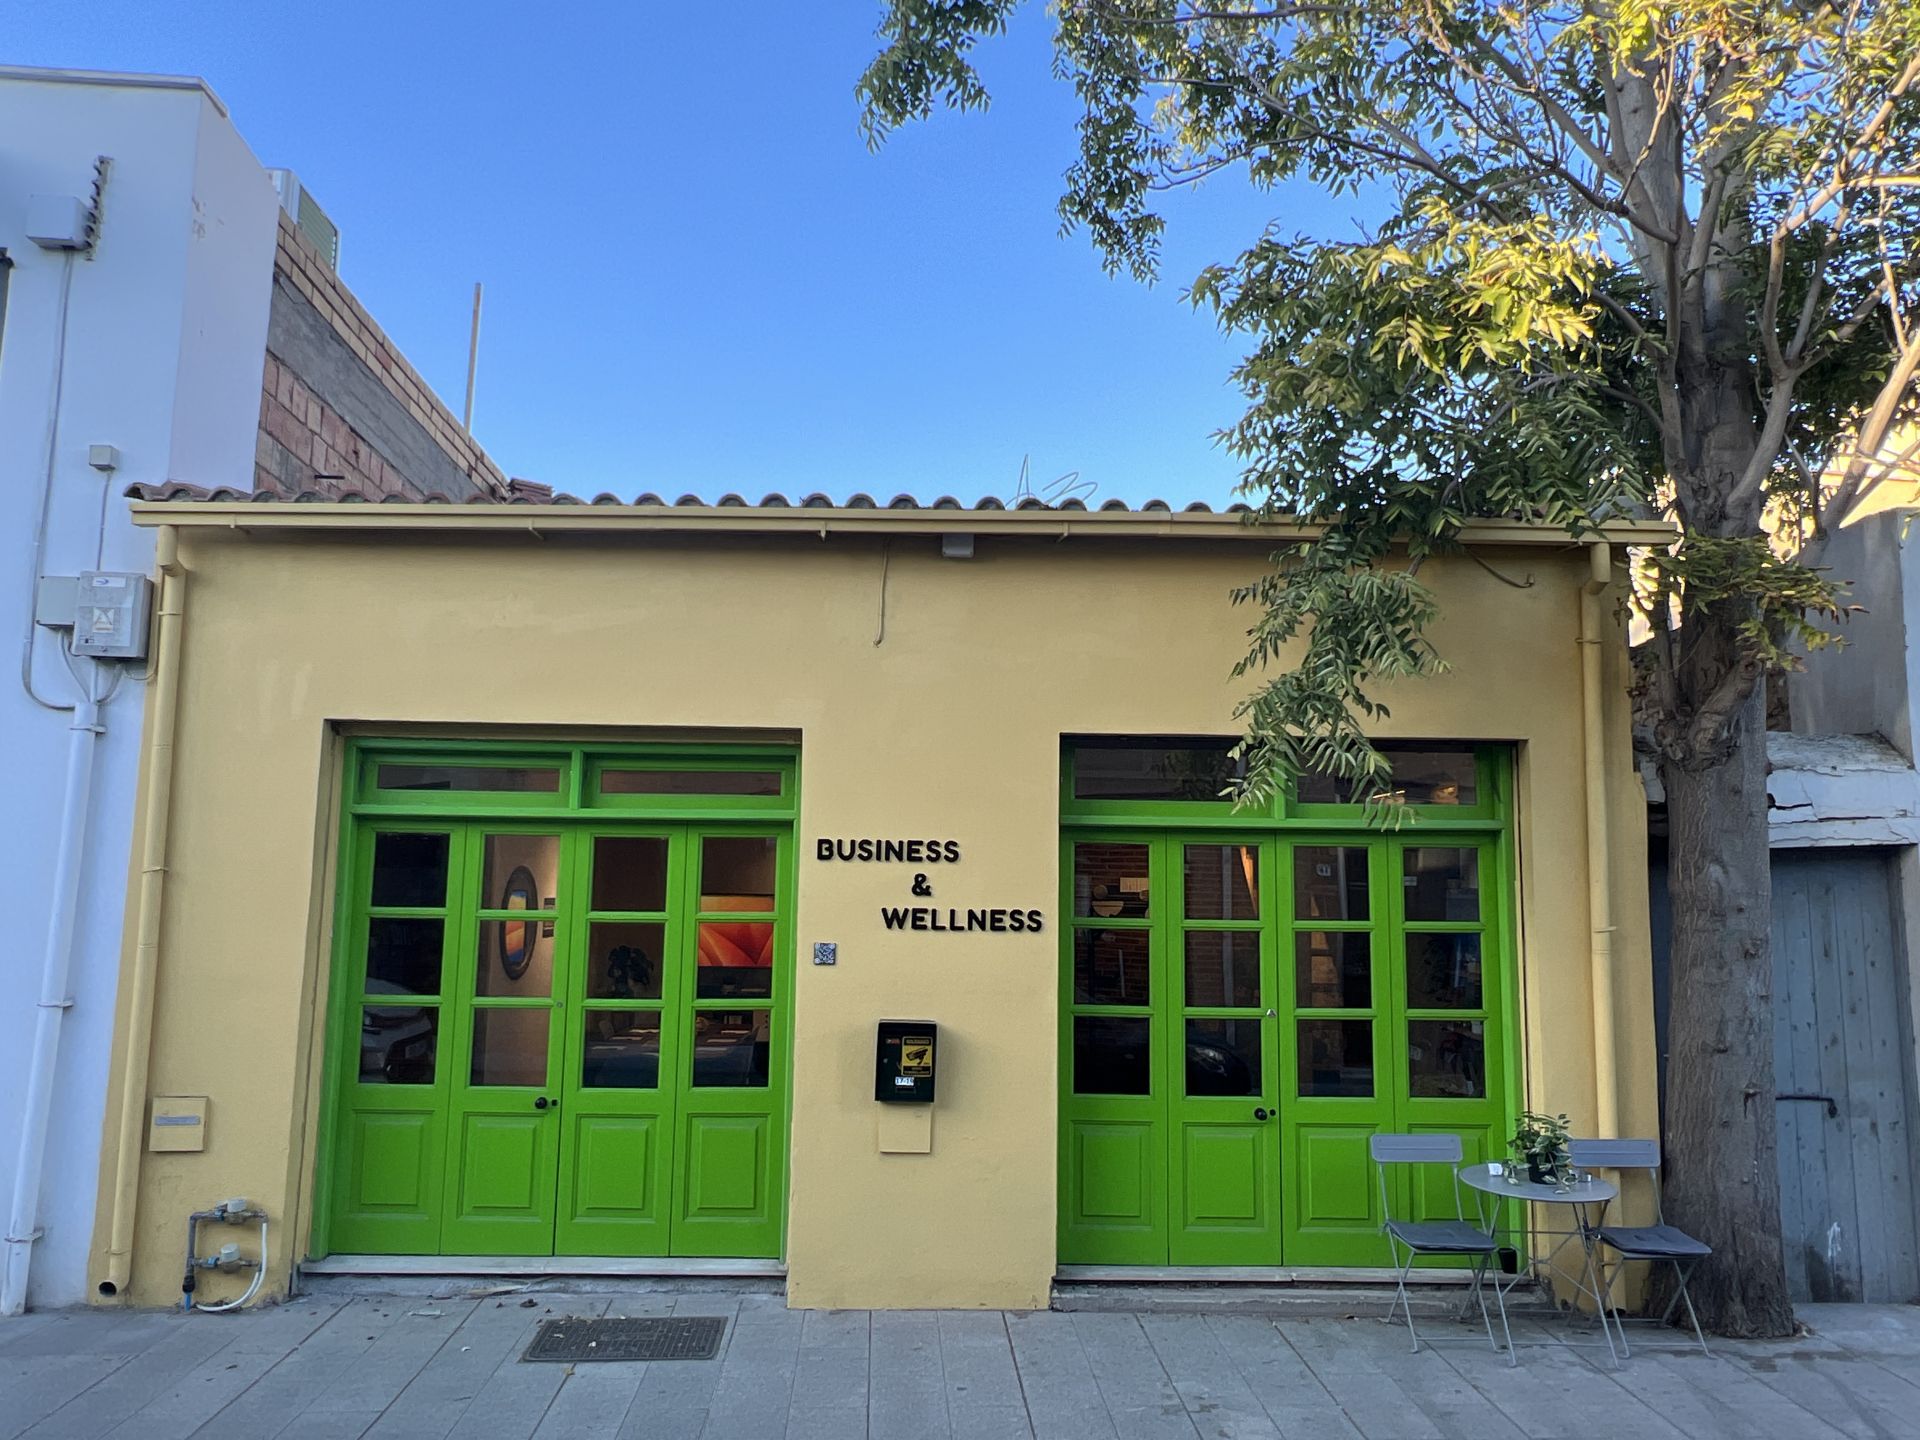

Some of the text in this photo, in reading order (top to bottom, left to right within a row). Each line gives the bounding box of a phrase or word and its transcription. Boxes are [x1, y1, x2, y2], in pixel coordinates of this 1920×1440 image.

[817, 839, 960, 862] BUSINESS
[911, 873, 932, 896] &
[881, 907, 1043, 932] WELLNESS
